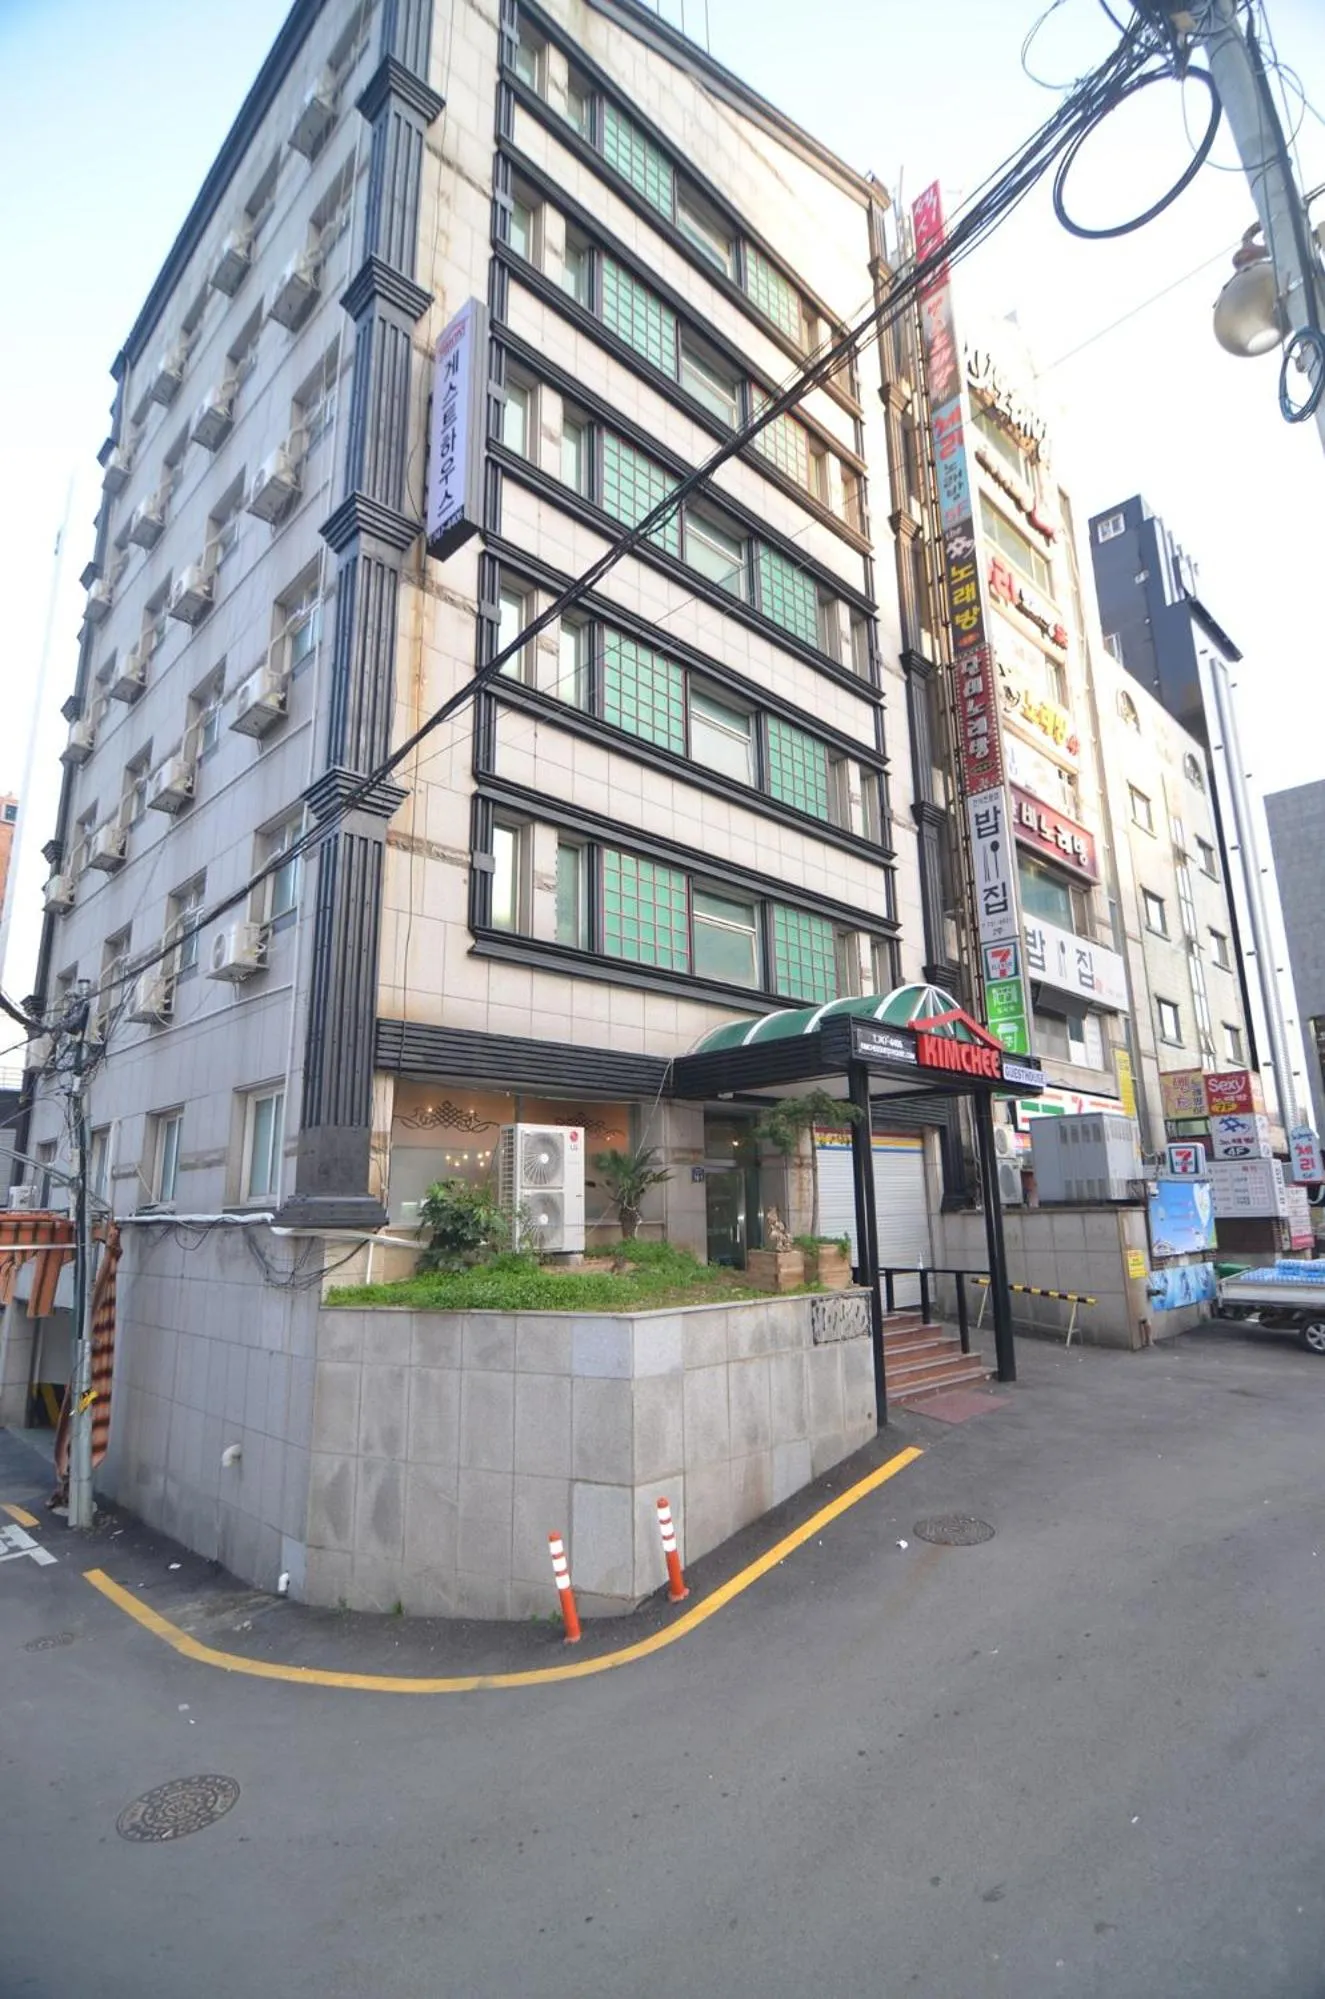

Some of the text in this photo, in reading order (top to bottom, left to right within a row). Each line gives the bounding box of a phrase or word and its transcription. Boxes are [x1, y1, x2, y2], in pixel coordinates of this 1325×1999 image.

[438, 348, 461, 518] 게스트하우스
[950, 562, 981, 632] 노래방
[923, 1033, 1002, 1080] KIMCHEE
[1005, 1065, 1045, 1085] GUESTHOUSE
[1207, 1075, 1246, 1095] Sexy
[1217, 1103, 1232, 1111] 7F
[1227, 1147, 1245, 1156] 4F
